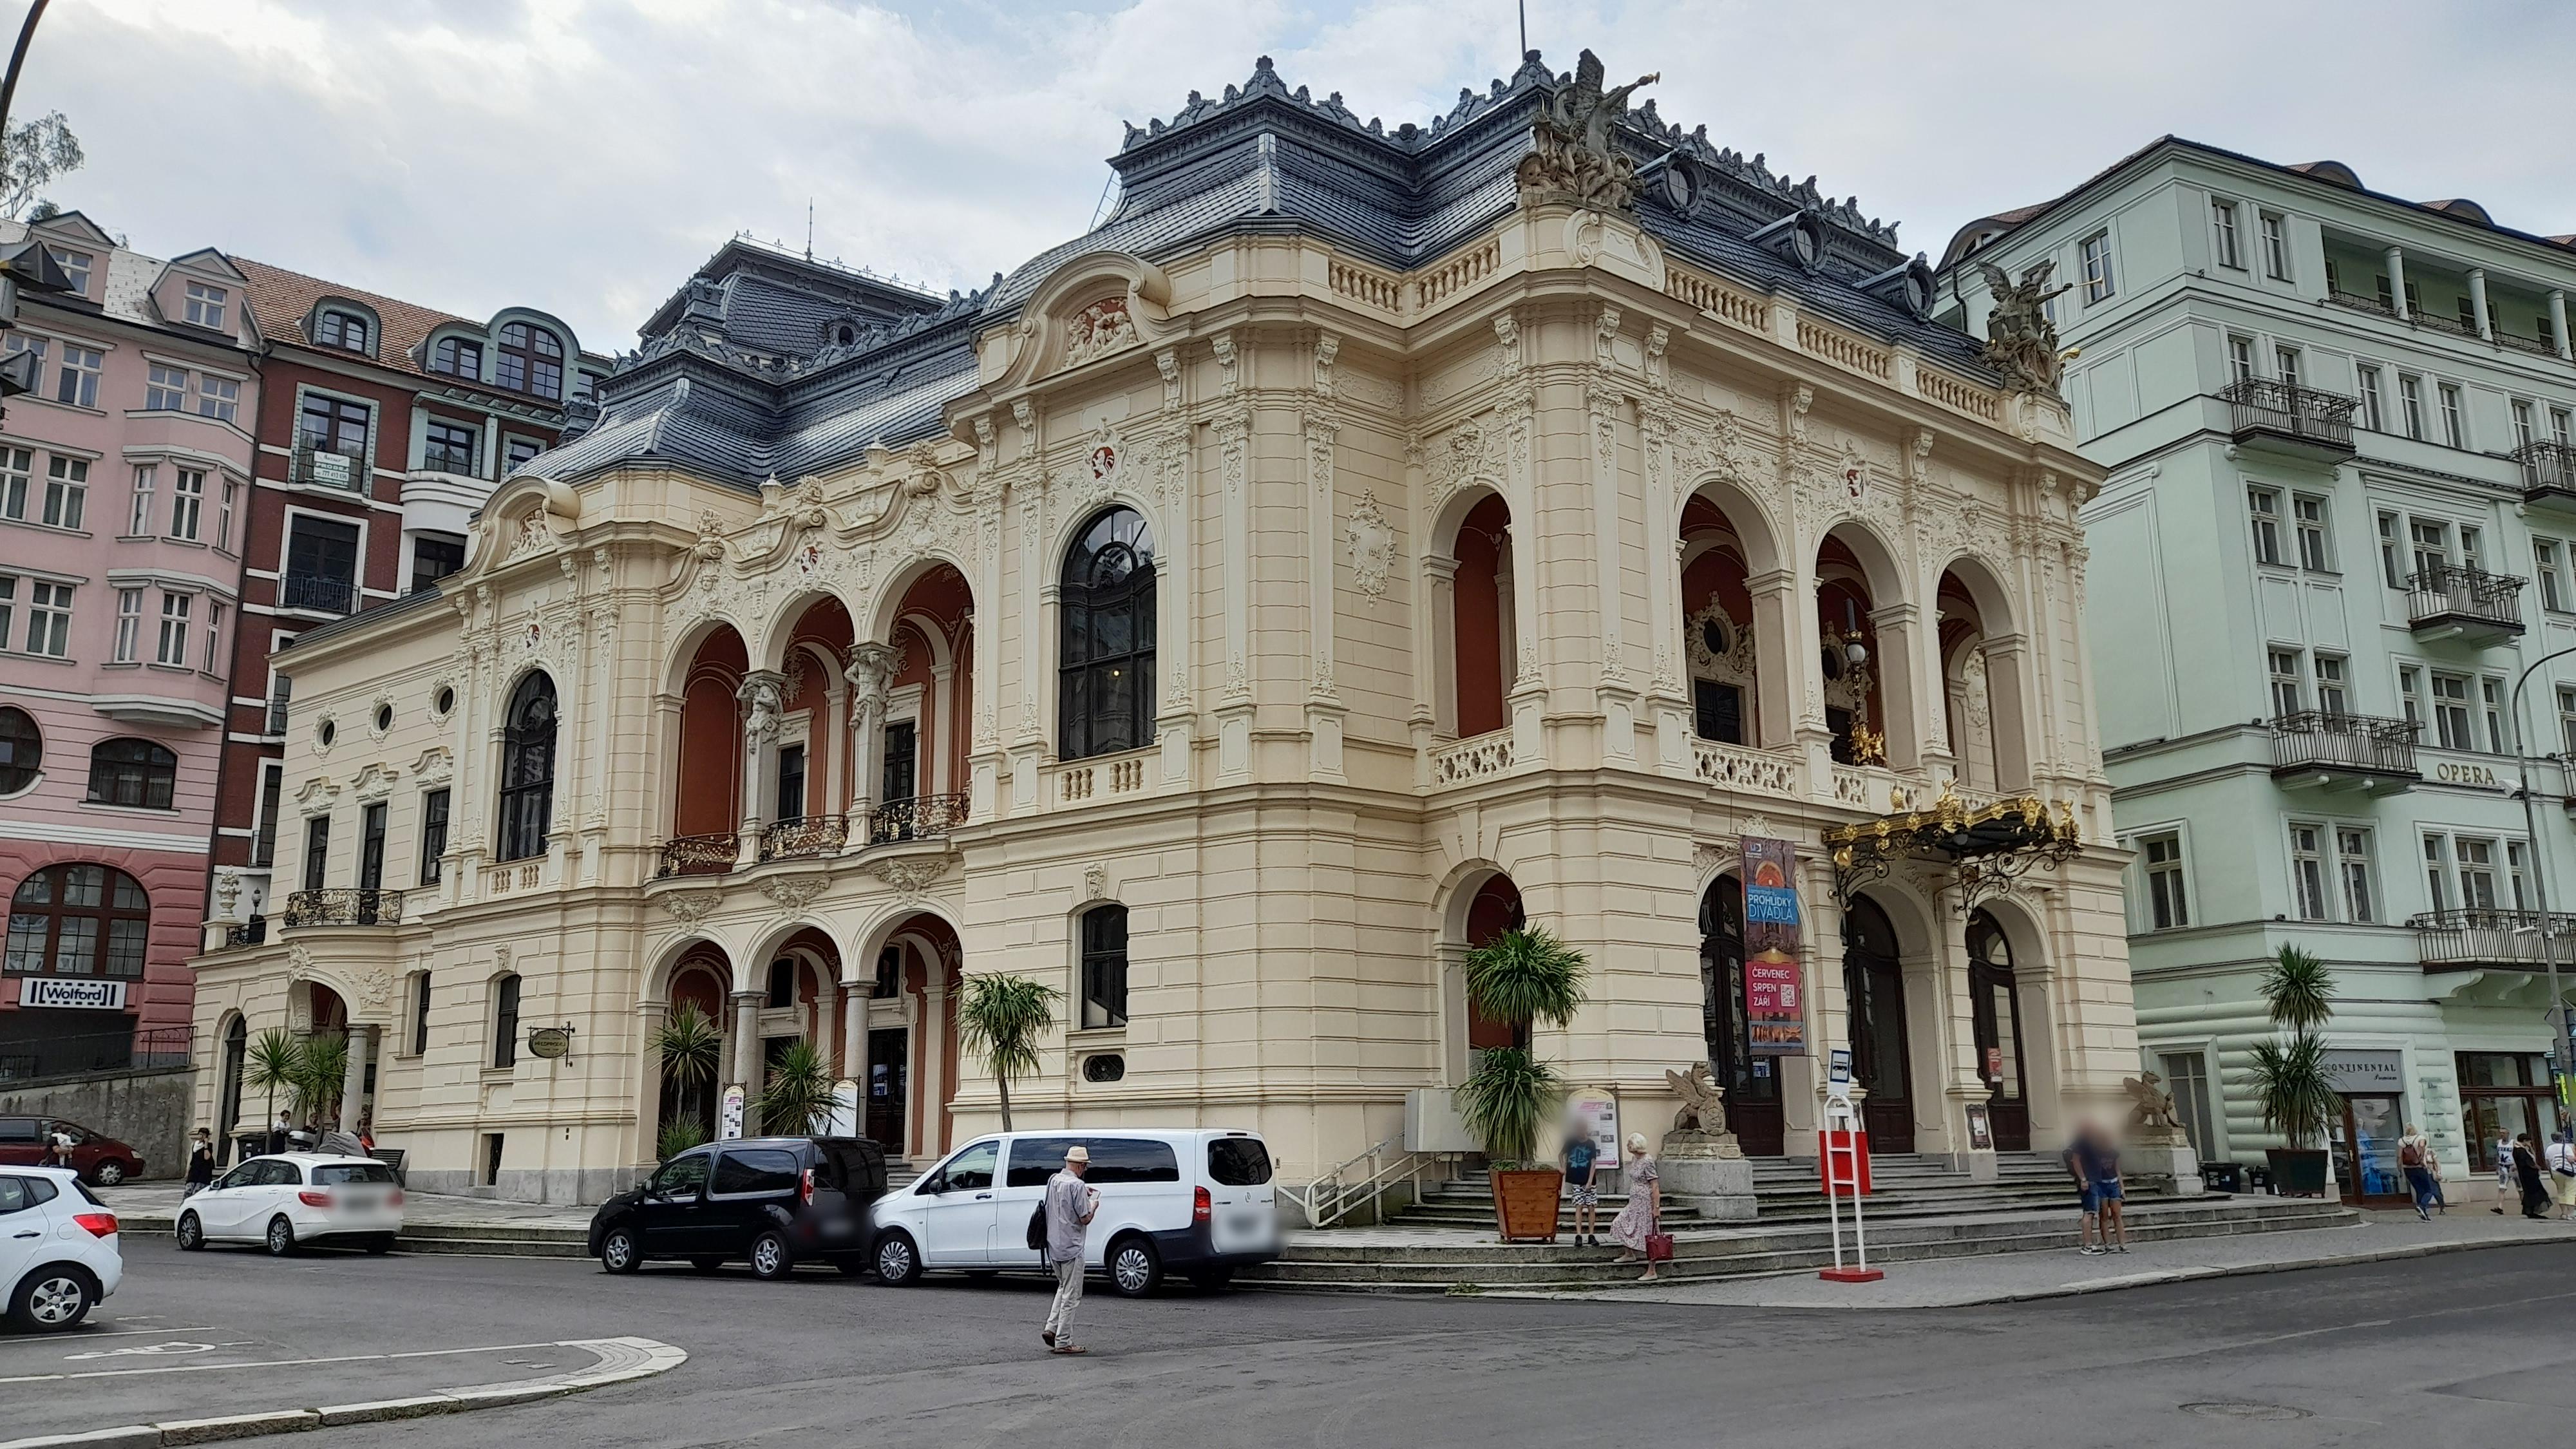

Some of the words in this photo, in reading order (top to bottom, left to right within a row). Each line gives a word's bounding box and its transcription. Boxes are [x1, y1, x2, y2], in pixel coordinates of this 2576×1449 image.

[316, 462, 349, 472] PRODEJ
[2437, 762, 2496, 785] OPERA
[1748, 893, 1792, 907] PROHLÍDKY
[1748, 904, 1793, 921] DIVADLA
[1752, 966, 1790, 979] ČERVENEC
[46, 987, 102, 1000] Wolford
[1752, 982, 1777, 993] SRPEN
[1753, 994, 1770, 1007] ZÁŘÍ
